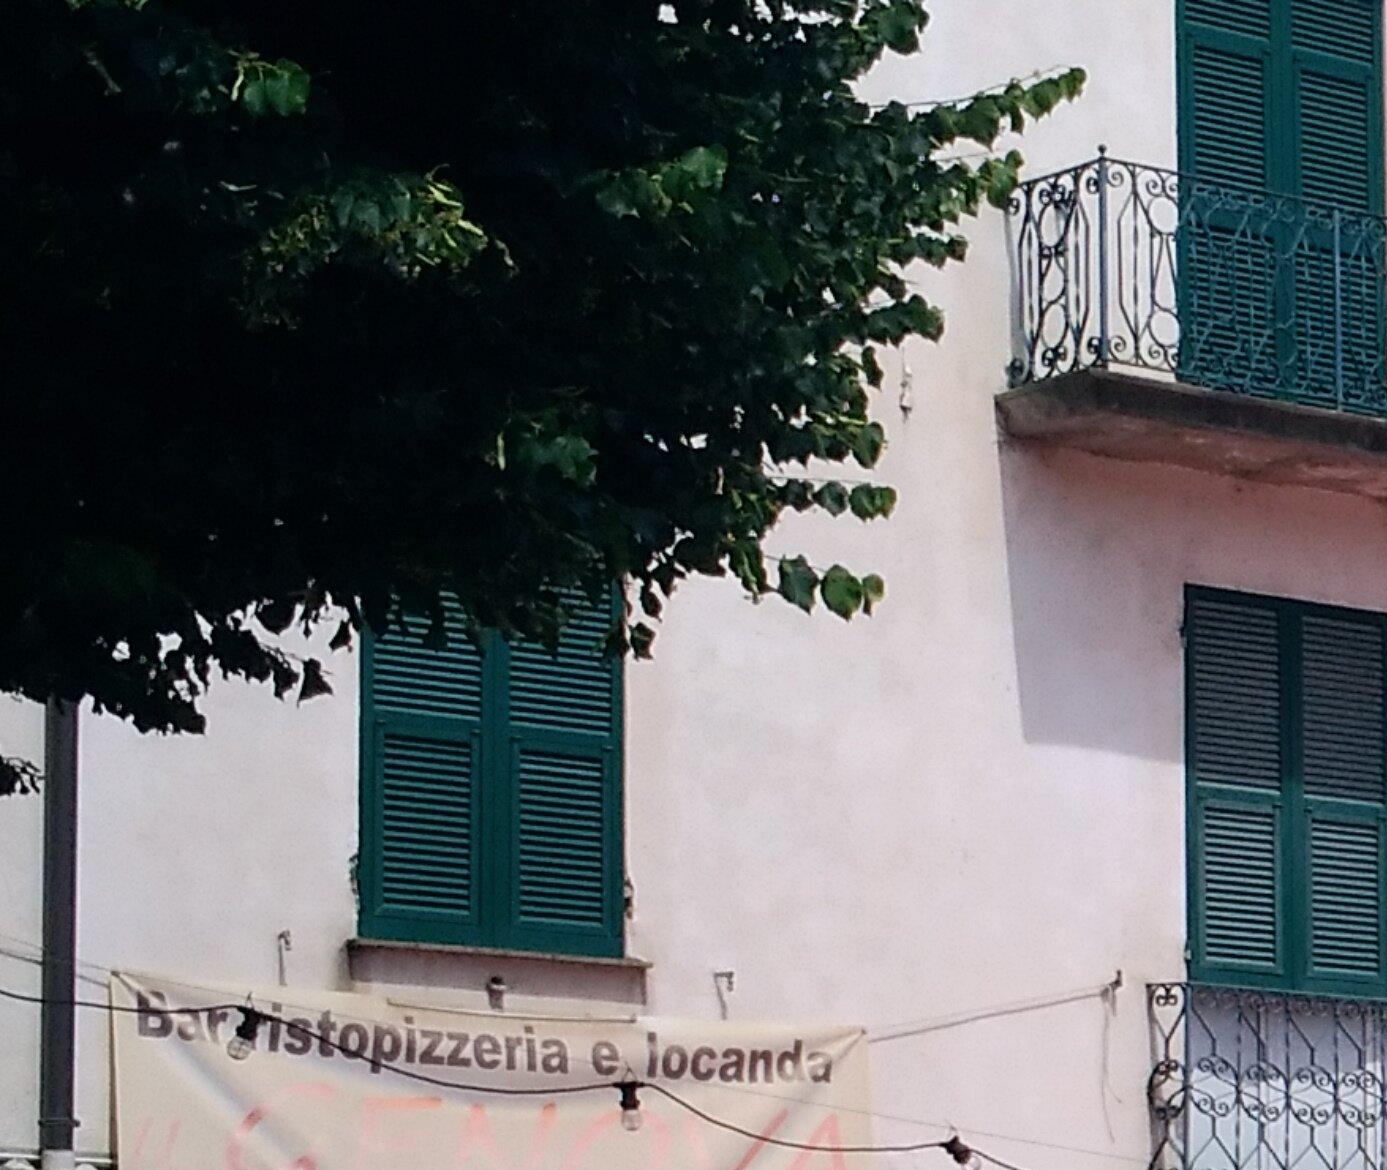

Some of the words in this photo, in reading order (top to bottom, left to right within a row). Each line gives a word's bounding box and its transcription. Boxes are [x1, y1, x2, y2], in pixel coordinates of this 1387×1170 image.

[136, 990, 228, 1046] Bar
[591, 1040, 619, 1077] e
[645, 1032, 834, 1084] locanda
